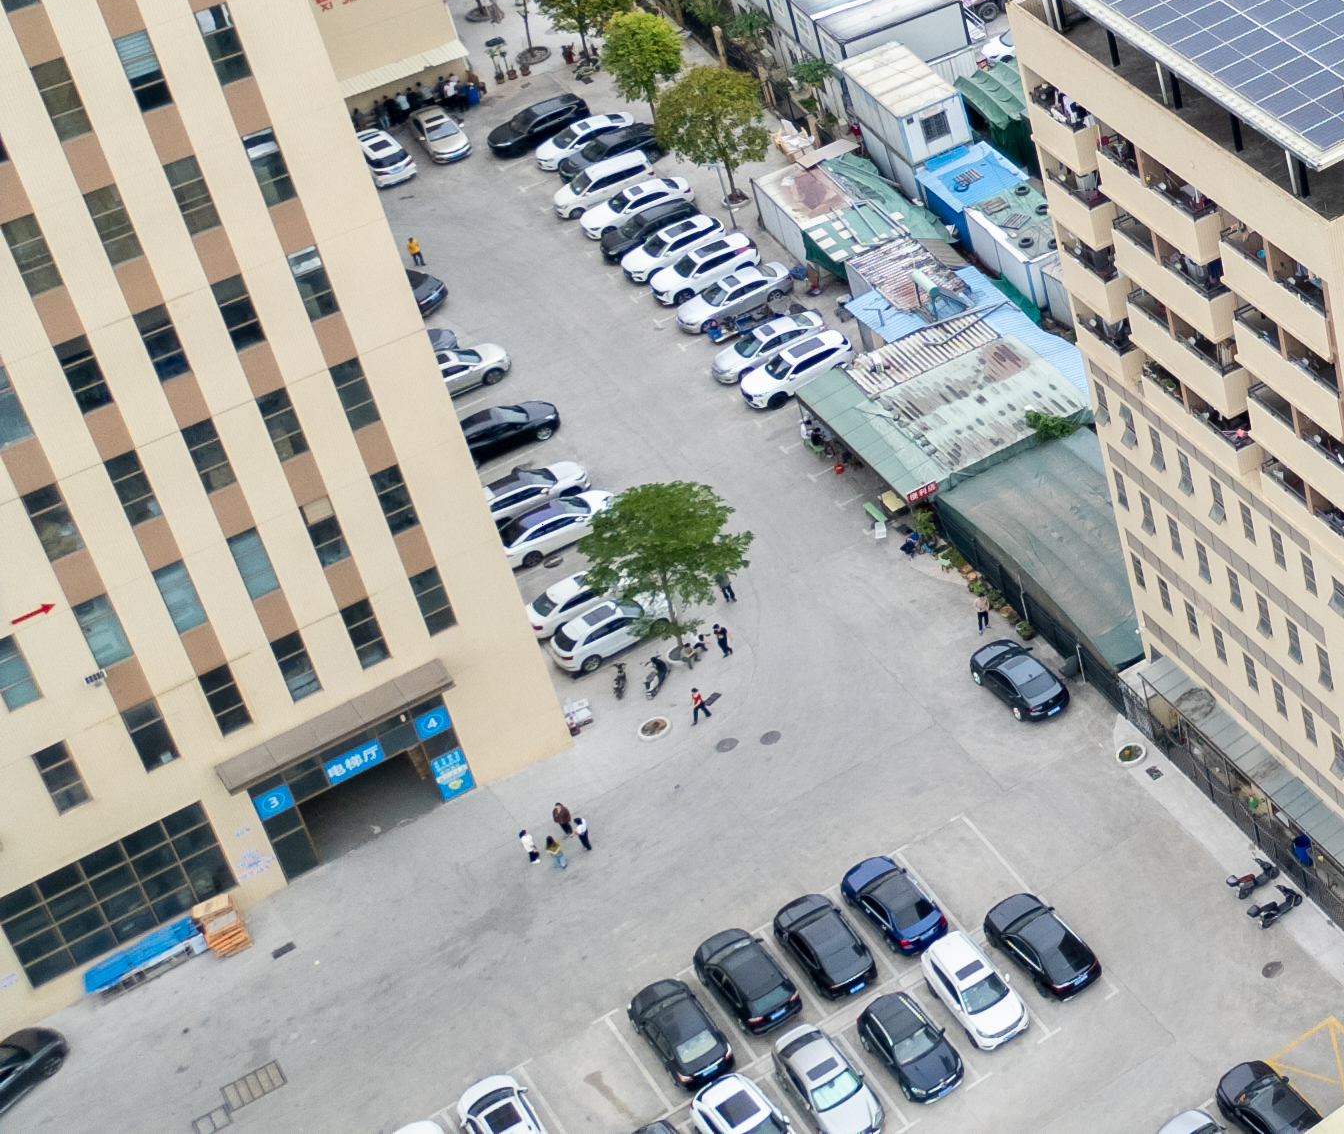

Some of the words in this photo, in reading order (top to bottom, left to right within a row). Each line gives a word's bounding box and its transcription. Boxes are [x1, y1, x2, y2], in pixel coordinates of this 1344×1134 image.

[320, 1, 334, 12] XI
[427, 717, 438, 729] 4
[327, 744, 378, 778] 电梯厅
[268, 796, 280, 809] 3
